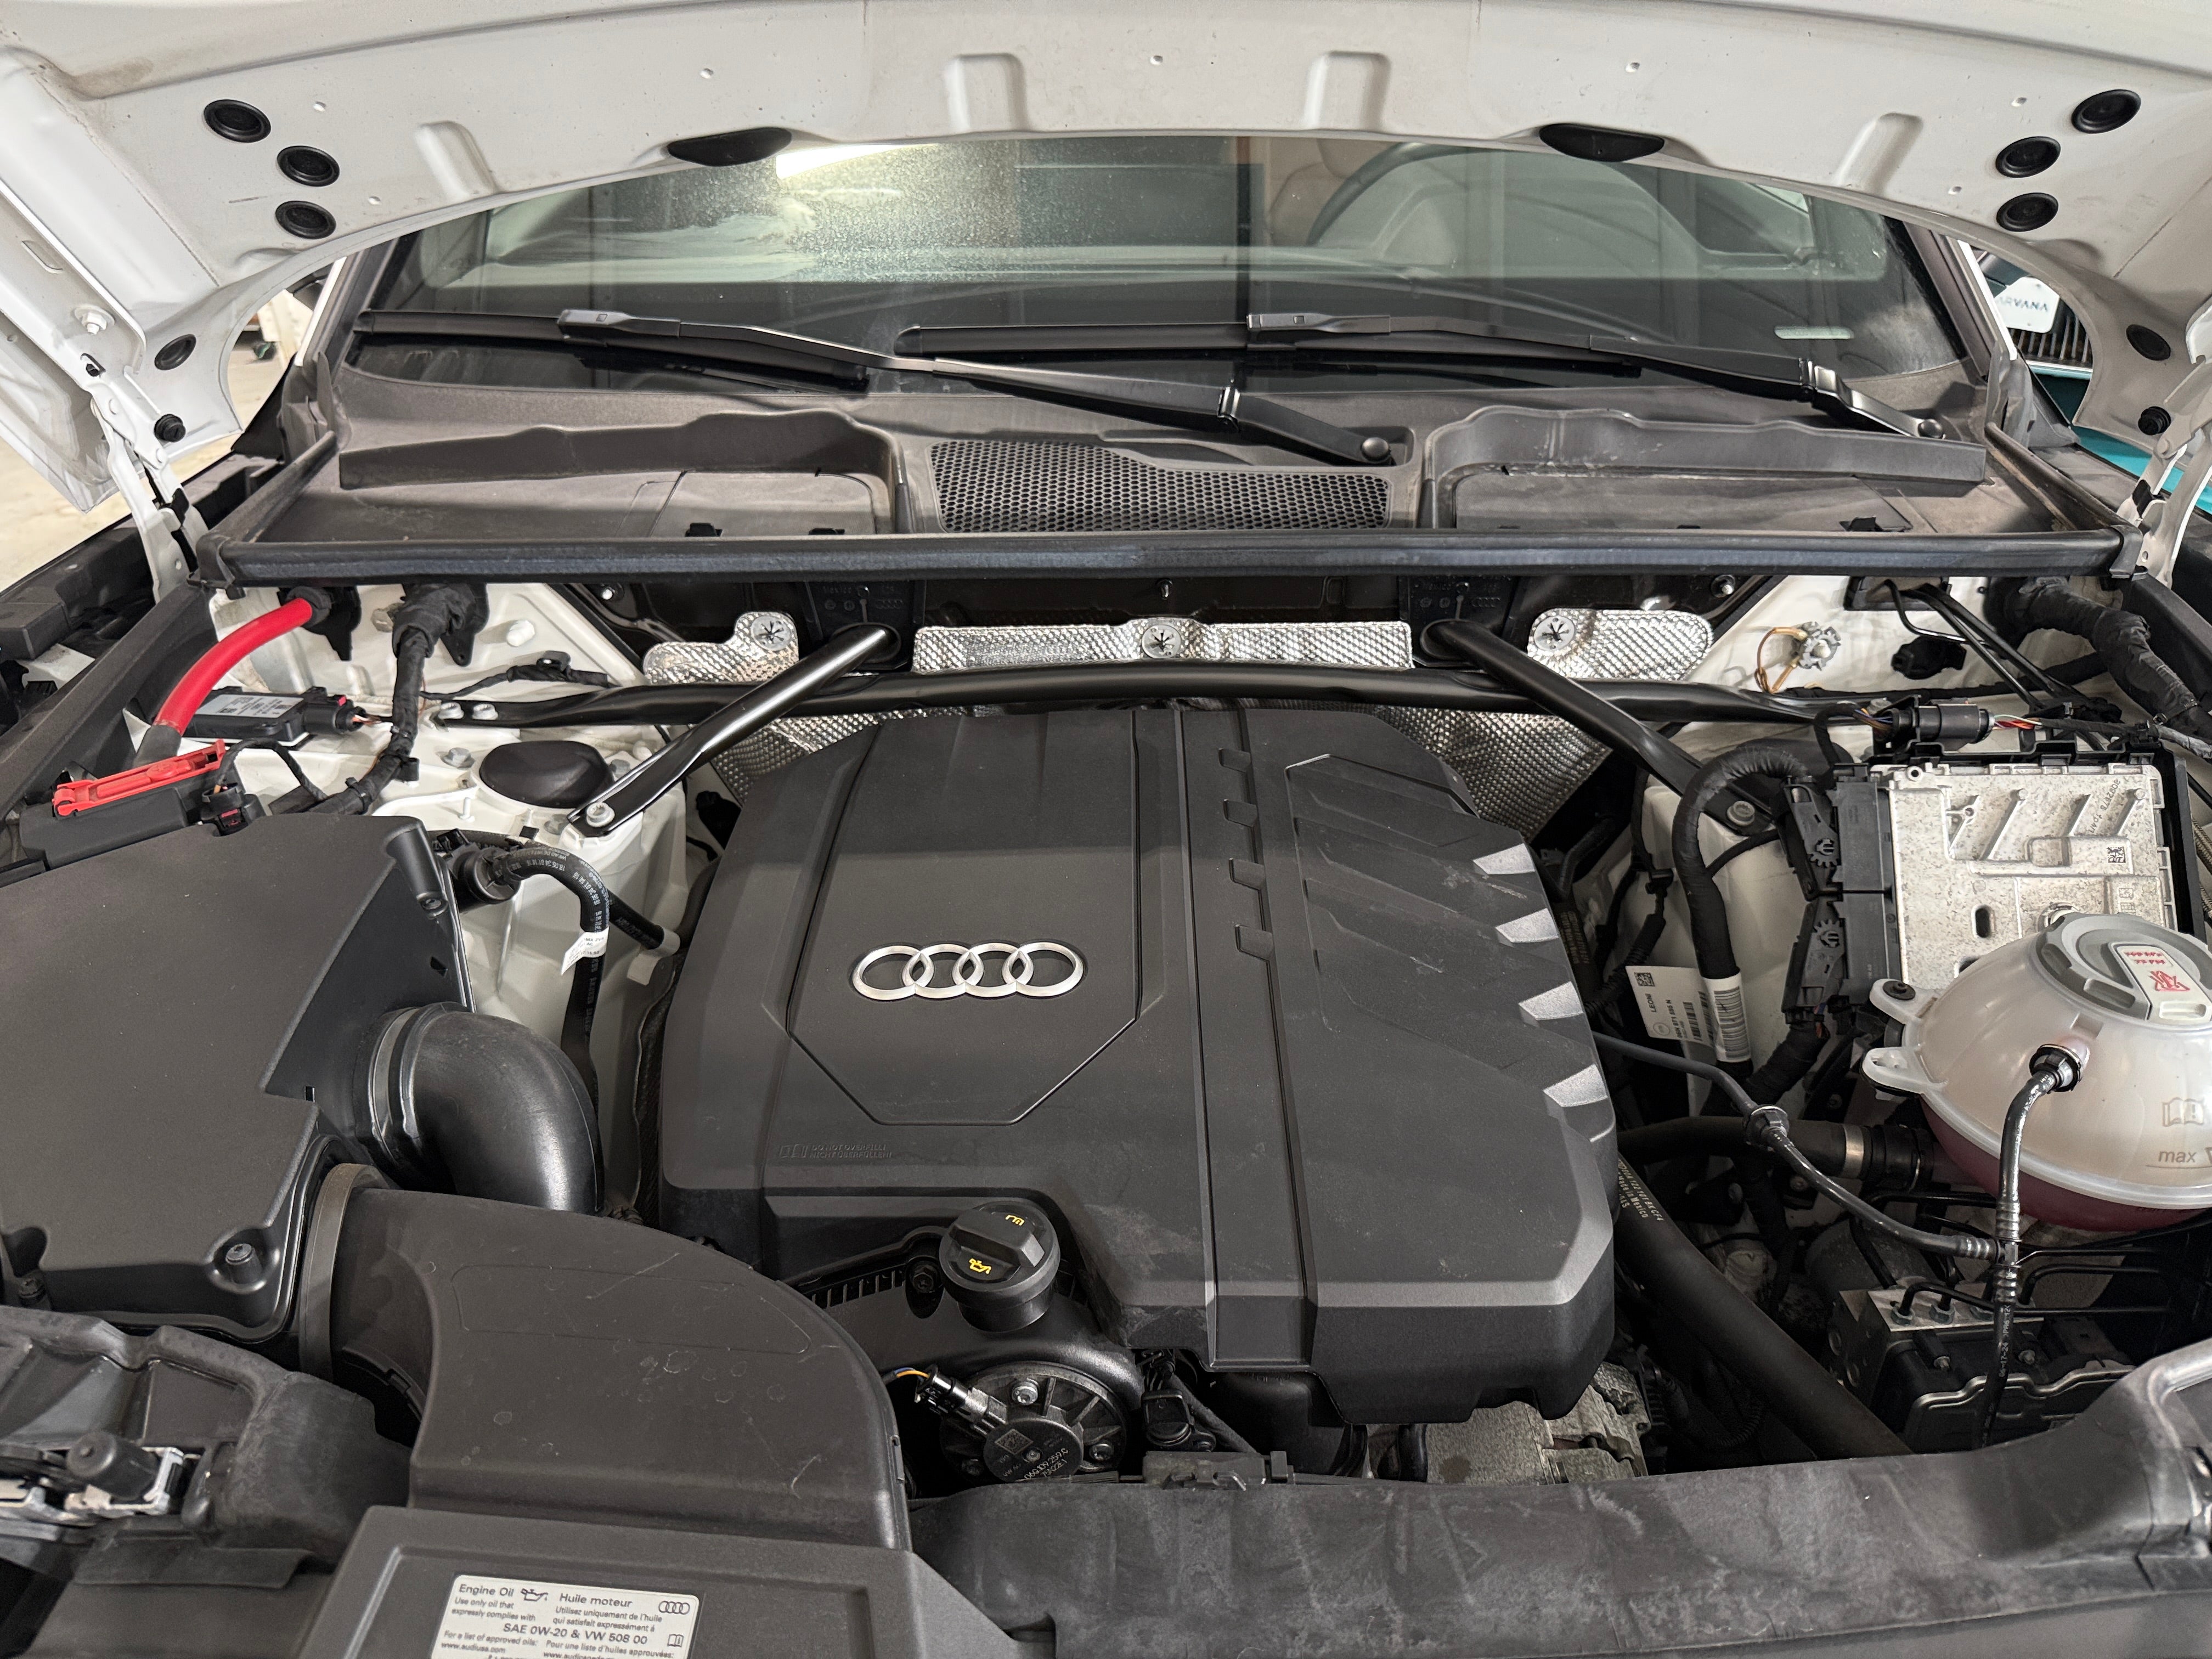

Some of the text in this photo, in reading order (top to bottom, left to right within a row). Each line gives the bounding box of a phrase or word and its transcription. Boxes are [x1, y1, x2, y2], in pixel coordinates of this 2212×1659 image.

[1995, 296, 2049, 312] ARVANA
[1645, 993, 1656, 1012] LEONI
[2158, 1148, 2196, 1163] max
[1630, 1197, 1649, 1218] Mexico
[459, 1584, 514, 1596] Engine Oil
[470, 1599, 487, 1607] only
[559, 1593, 633, 1607] Huile moteur
[452, 1608, 485, 1618] expressly
[487, 1611, 519, 1621] complies
[555, 1606, 582, 1615] Utilisez
[583, 1609, 628, 1620] uniquement
[552, 1616, 565, 1625] qui
[566, 1618, 595, 1627] satisfait
[597, 1621, 648, 1632] expressément
[444, 1629, 456, 1639] For
[464, 1632, 475, 1640] list
[476, 1633, 485, 1641] of
[486, 1635, 521, 1645] approved
[503, 1623, 648, 1645] SAE 0W-20 & VW 508 00
[546, 1639, 563, 1649] Pour
[581, 1642, 596, 1651] liste
